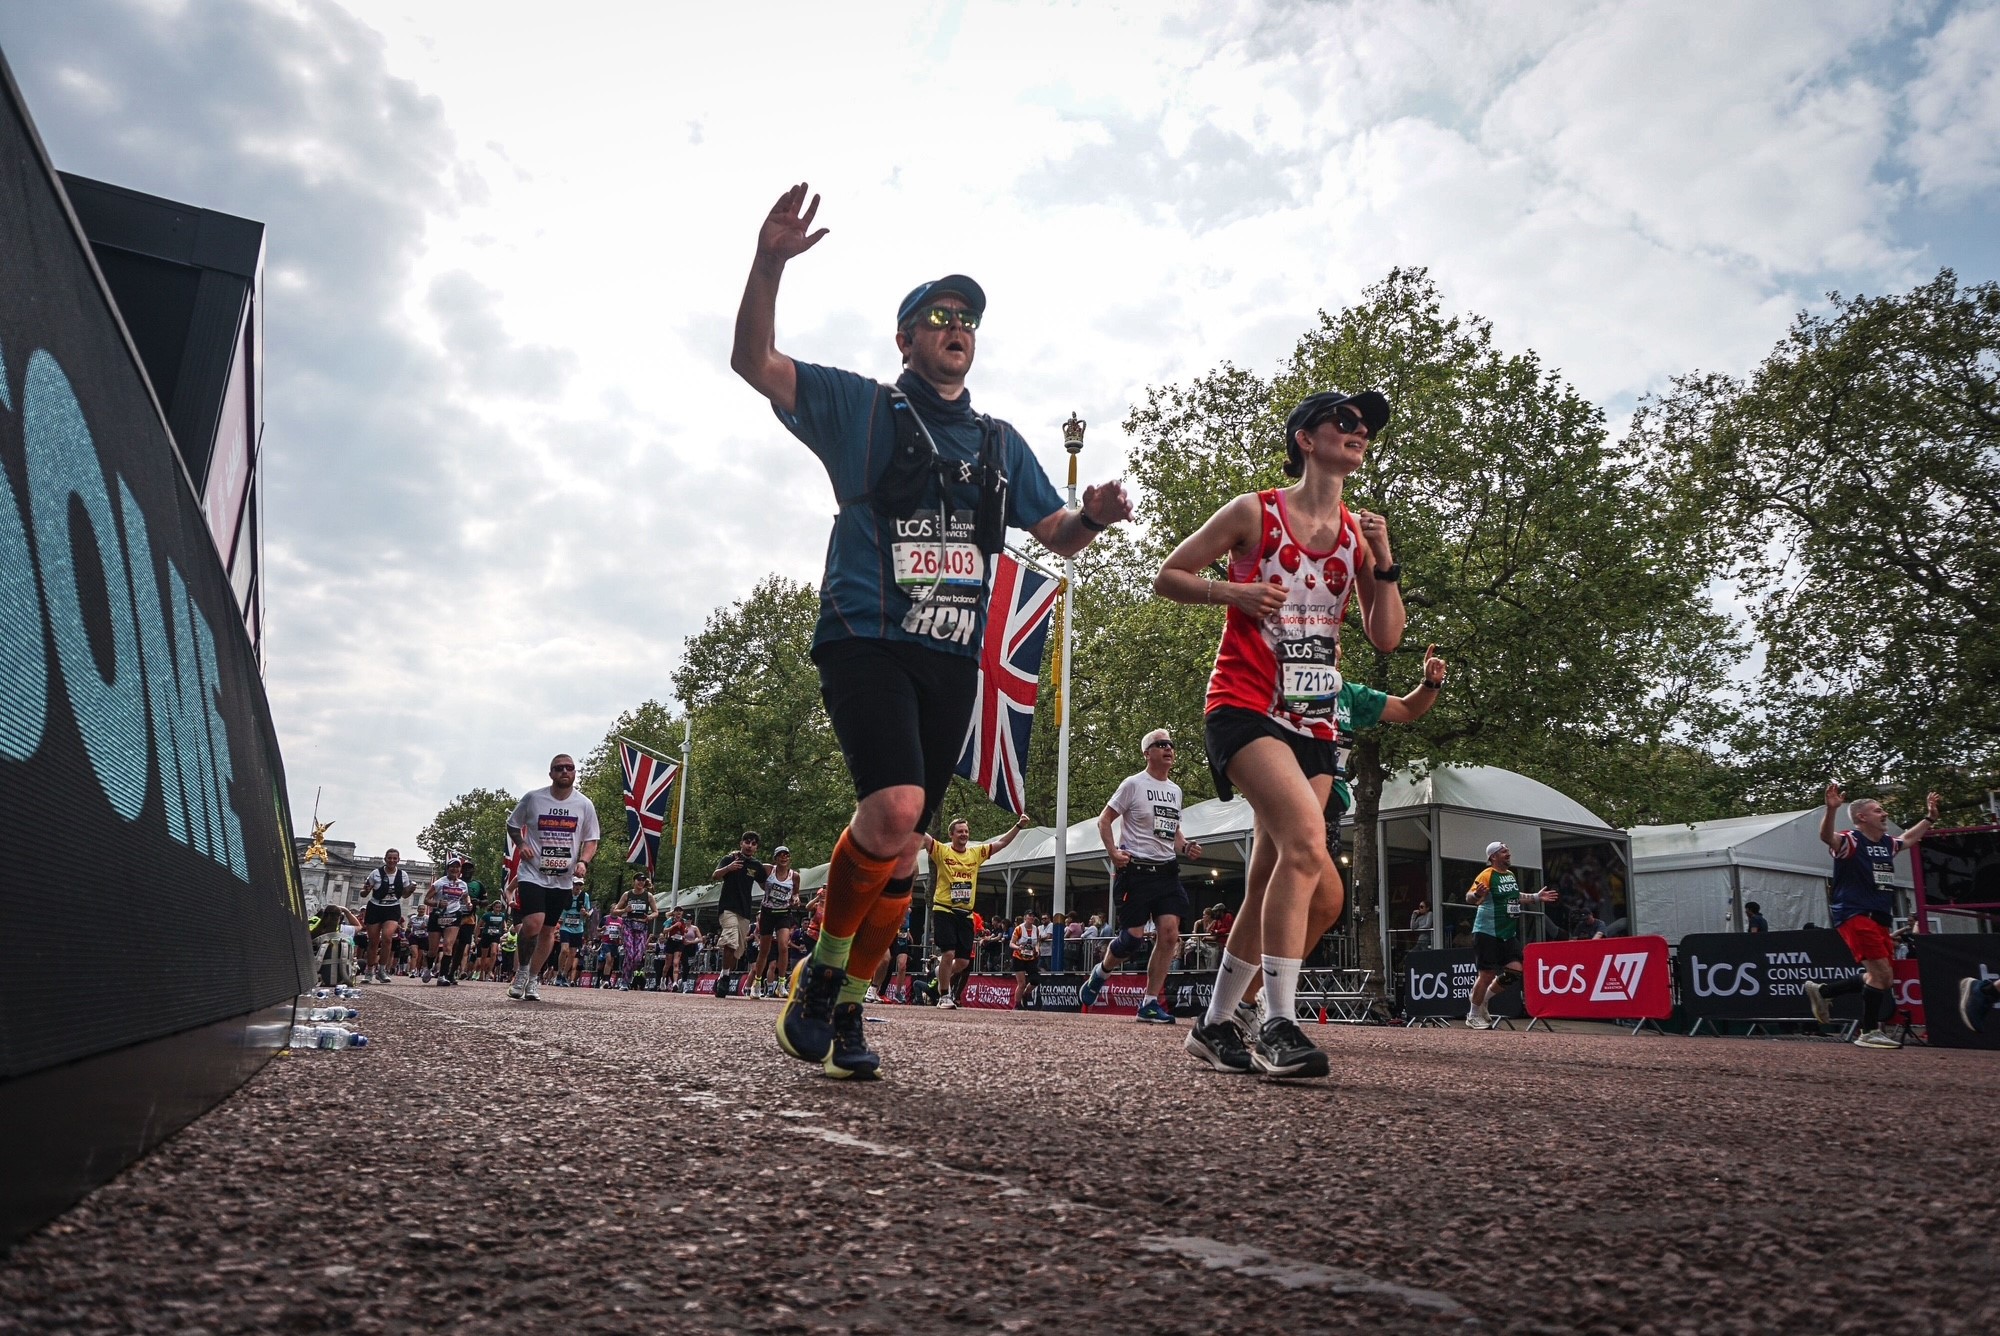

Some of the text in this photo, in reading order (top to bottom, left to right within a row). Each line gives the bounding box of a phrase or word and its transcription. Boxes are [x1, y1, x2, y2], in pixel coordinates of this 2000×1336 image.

[896, 518, 933, 537] tcs
[910, 551, 974, 575] 26403
[0, 343, 250, 884] OME
[1283, 643, 1313, 659] tcs
[1294, 671, 1335, 692] 72112
[1147, 789, 1176, 803] DILLON
[549, 808, 569, 816] JOSH
[952, 871, 972, 879] JACK
[1766, 952, 1812, 964] TATA
[1538, 958, 1587, 995] tcs
[1691, 955, 1760, 997] tcs
[1768, 967, 1866, 980] CONSULTANC
[1050, 985, 1077, 996] LONDON
[1411, 968, 1449, 1001] tcs
[1041, 995, 1080, 1006] MARATHON
